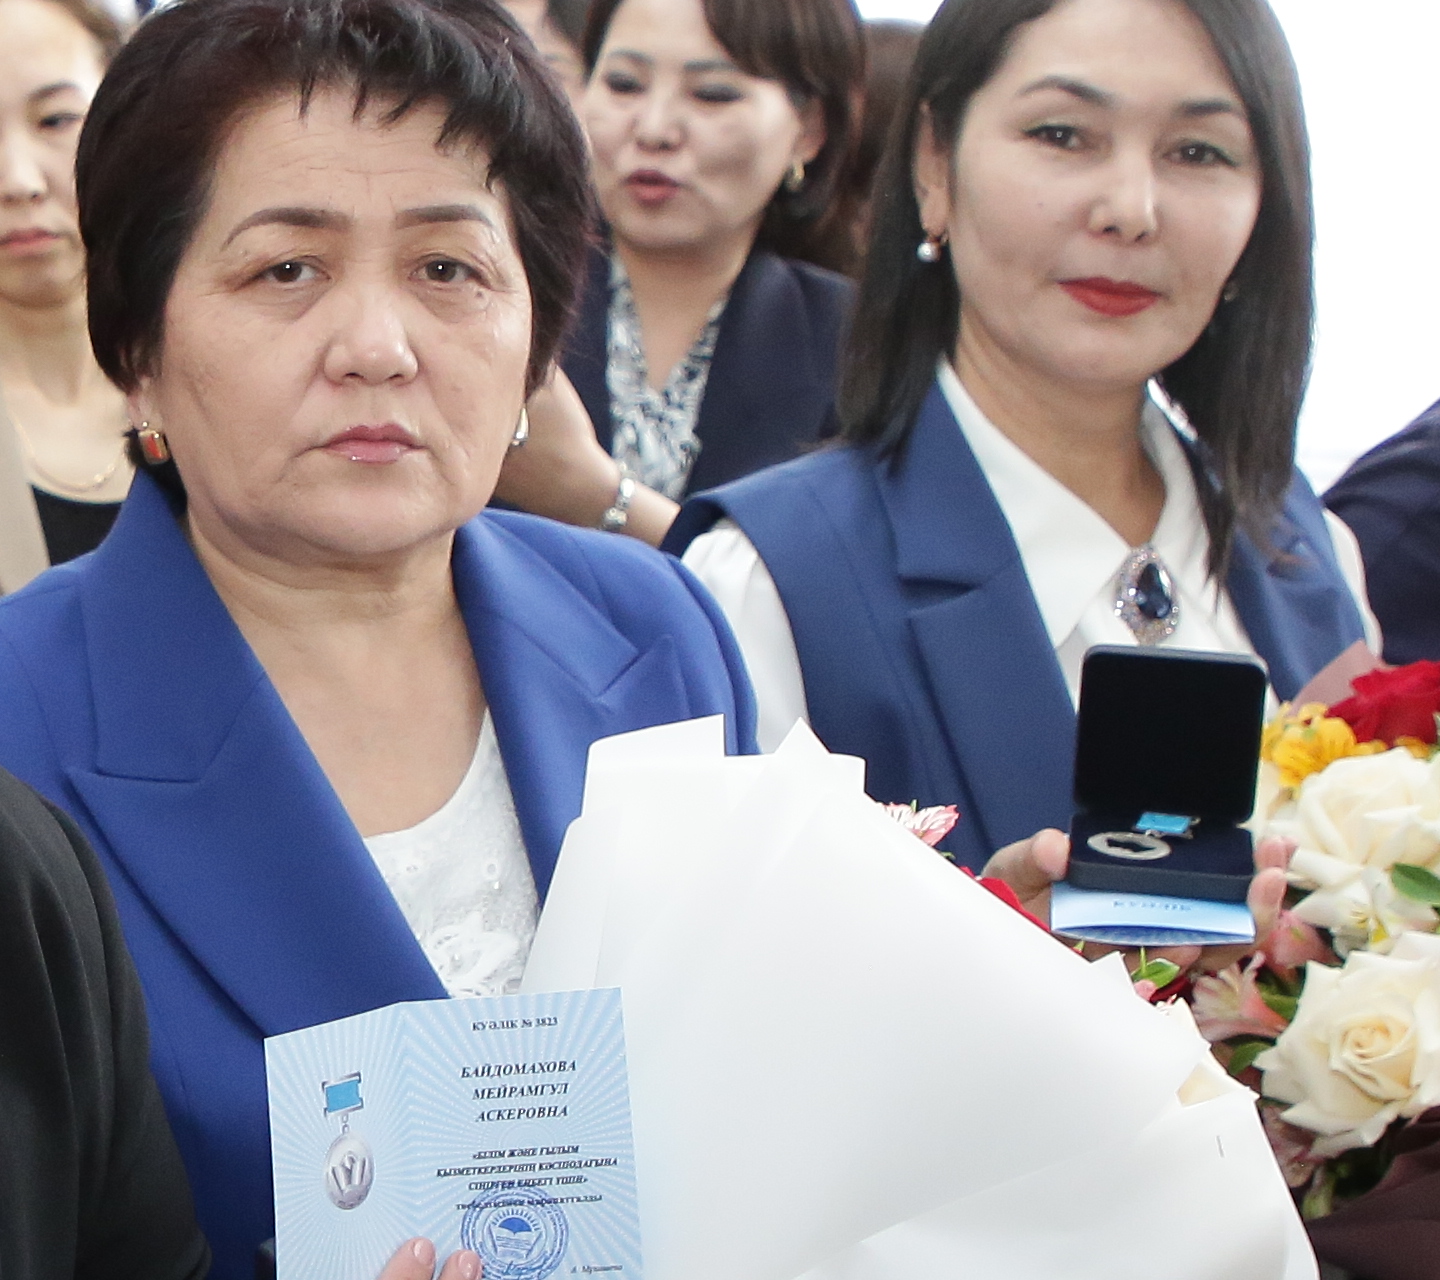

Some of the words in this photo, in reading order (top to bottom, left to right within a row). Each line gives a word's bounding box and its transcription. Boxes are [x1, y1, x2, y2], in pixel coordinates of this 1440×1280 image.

[460, 1060, 577, 1078] БАЙДОМАХОВА
[472, 1083, 569, 1101] МЕЙРАМГУЛ
[475, 1105, 568, 1122] АСКЕРОВНА
